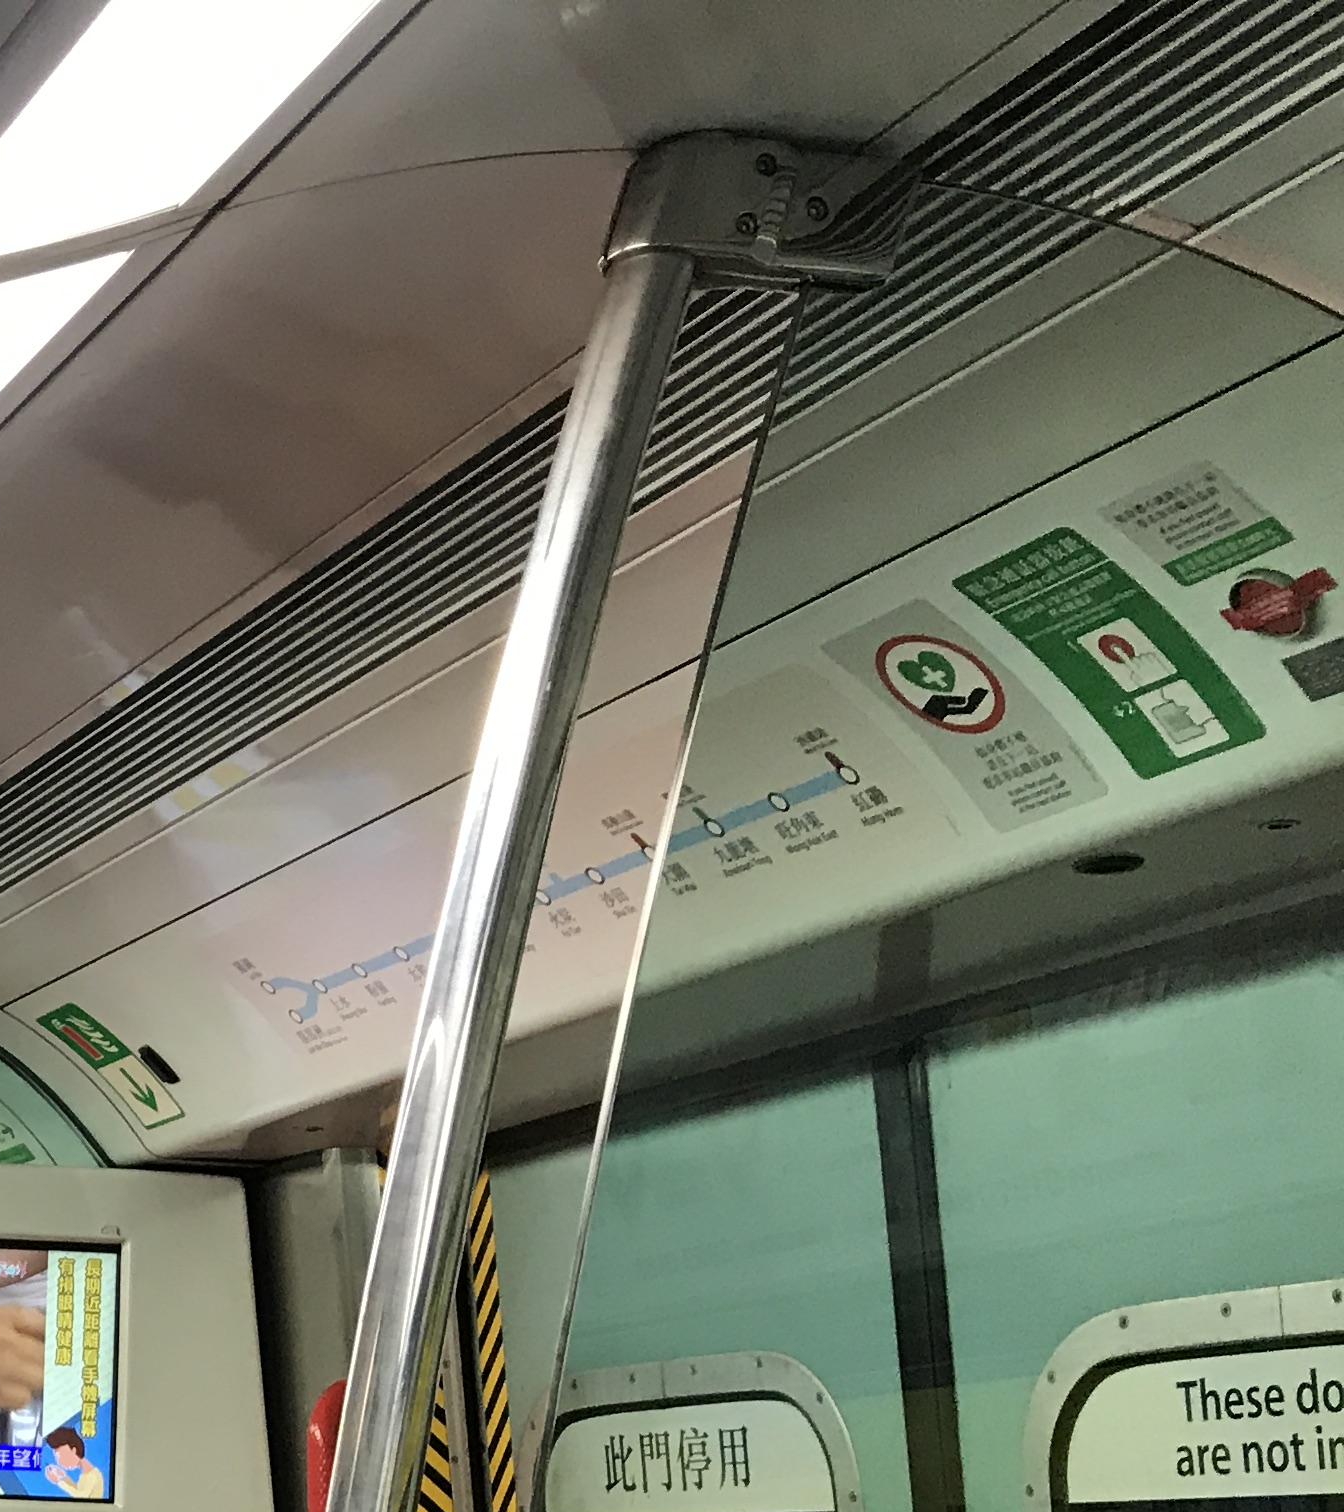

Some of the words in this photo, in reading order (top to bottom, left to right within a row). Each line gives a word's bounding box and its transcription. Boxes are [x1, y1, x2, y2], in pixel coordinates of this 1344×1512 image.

[55, 1256, 75, 1366] 有損眼睛健康
[81, 1257, 103, 1438] 長期近距離看手機屏幕
[1175, 1376, 1286, 1422] These
[604, 1424, 751, 1494] 此門停用
[1176, 1442, 1231, 1477] are
[1242, 1432, 1306, 1473] not
